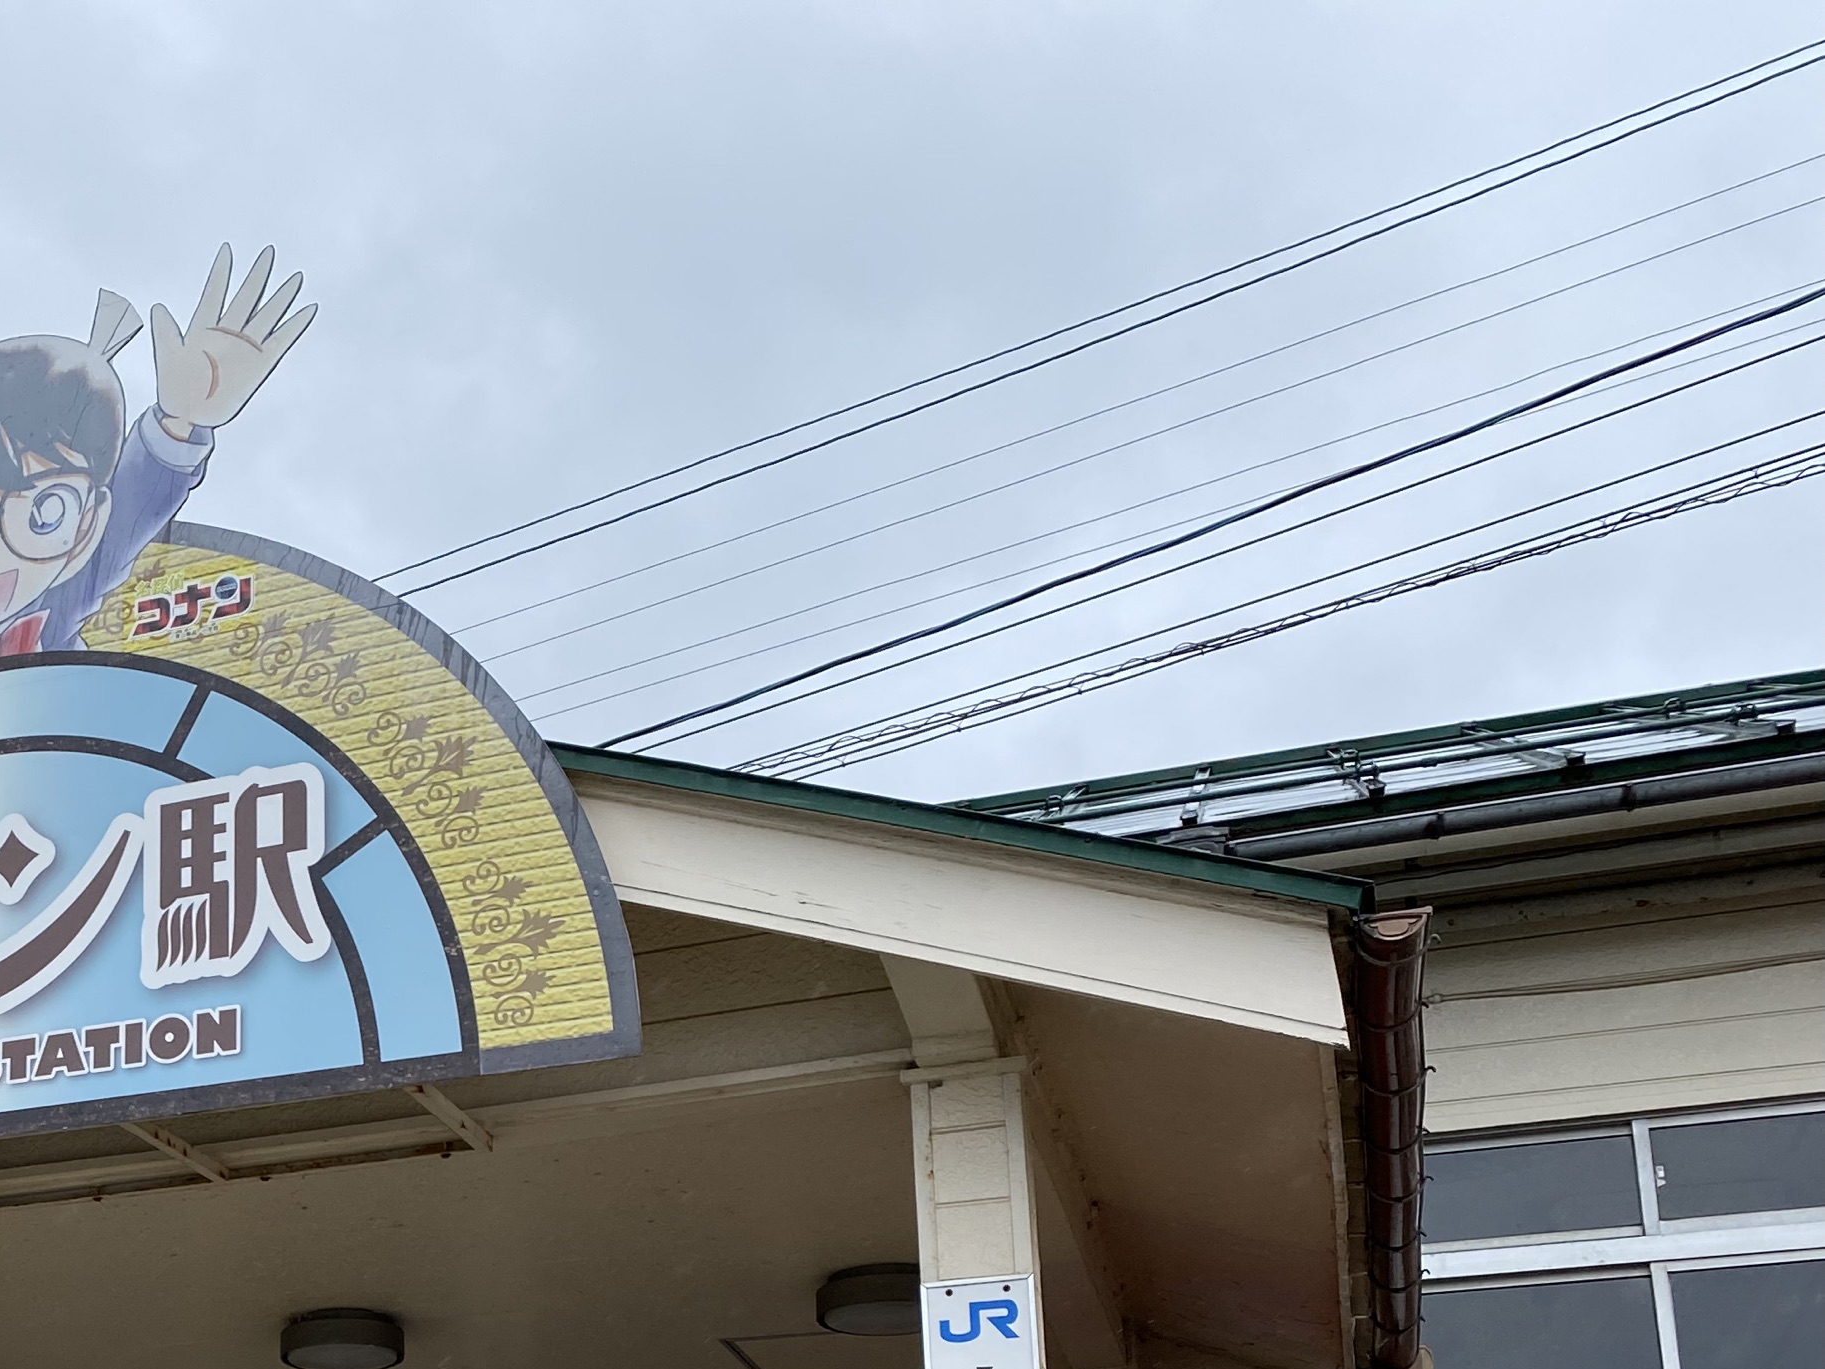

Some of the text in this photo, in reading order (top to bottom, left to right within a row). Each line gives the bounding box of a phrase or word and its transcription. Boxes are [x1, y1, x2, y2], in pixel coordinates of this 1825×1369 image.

[131, 576, 252, 637] コナン
[939, 1299, 1019, 1343] JR
